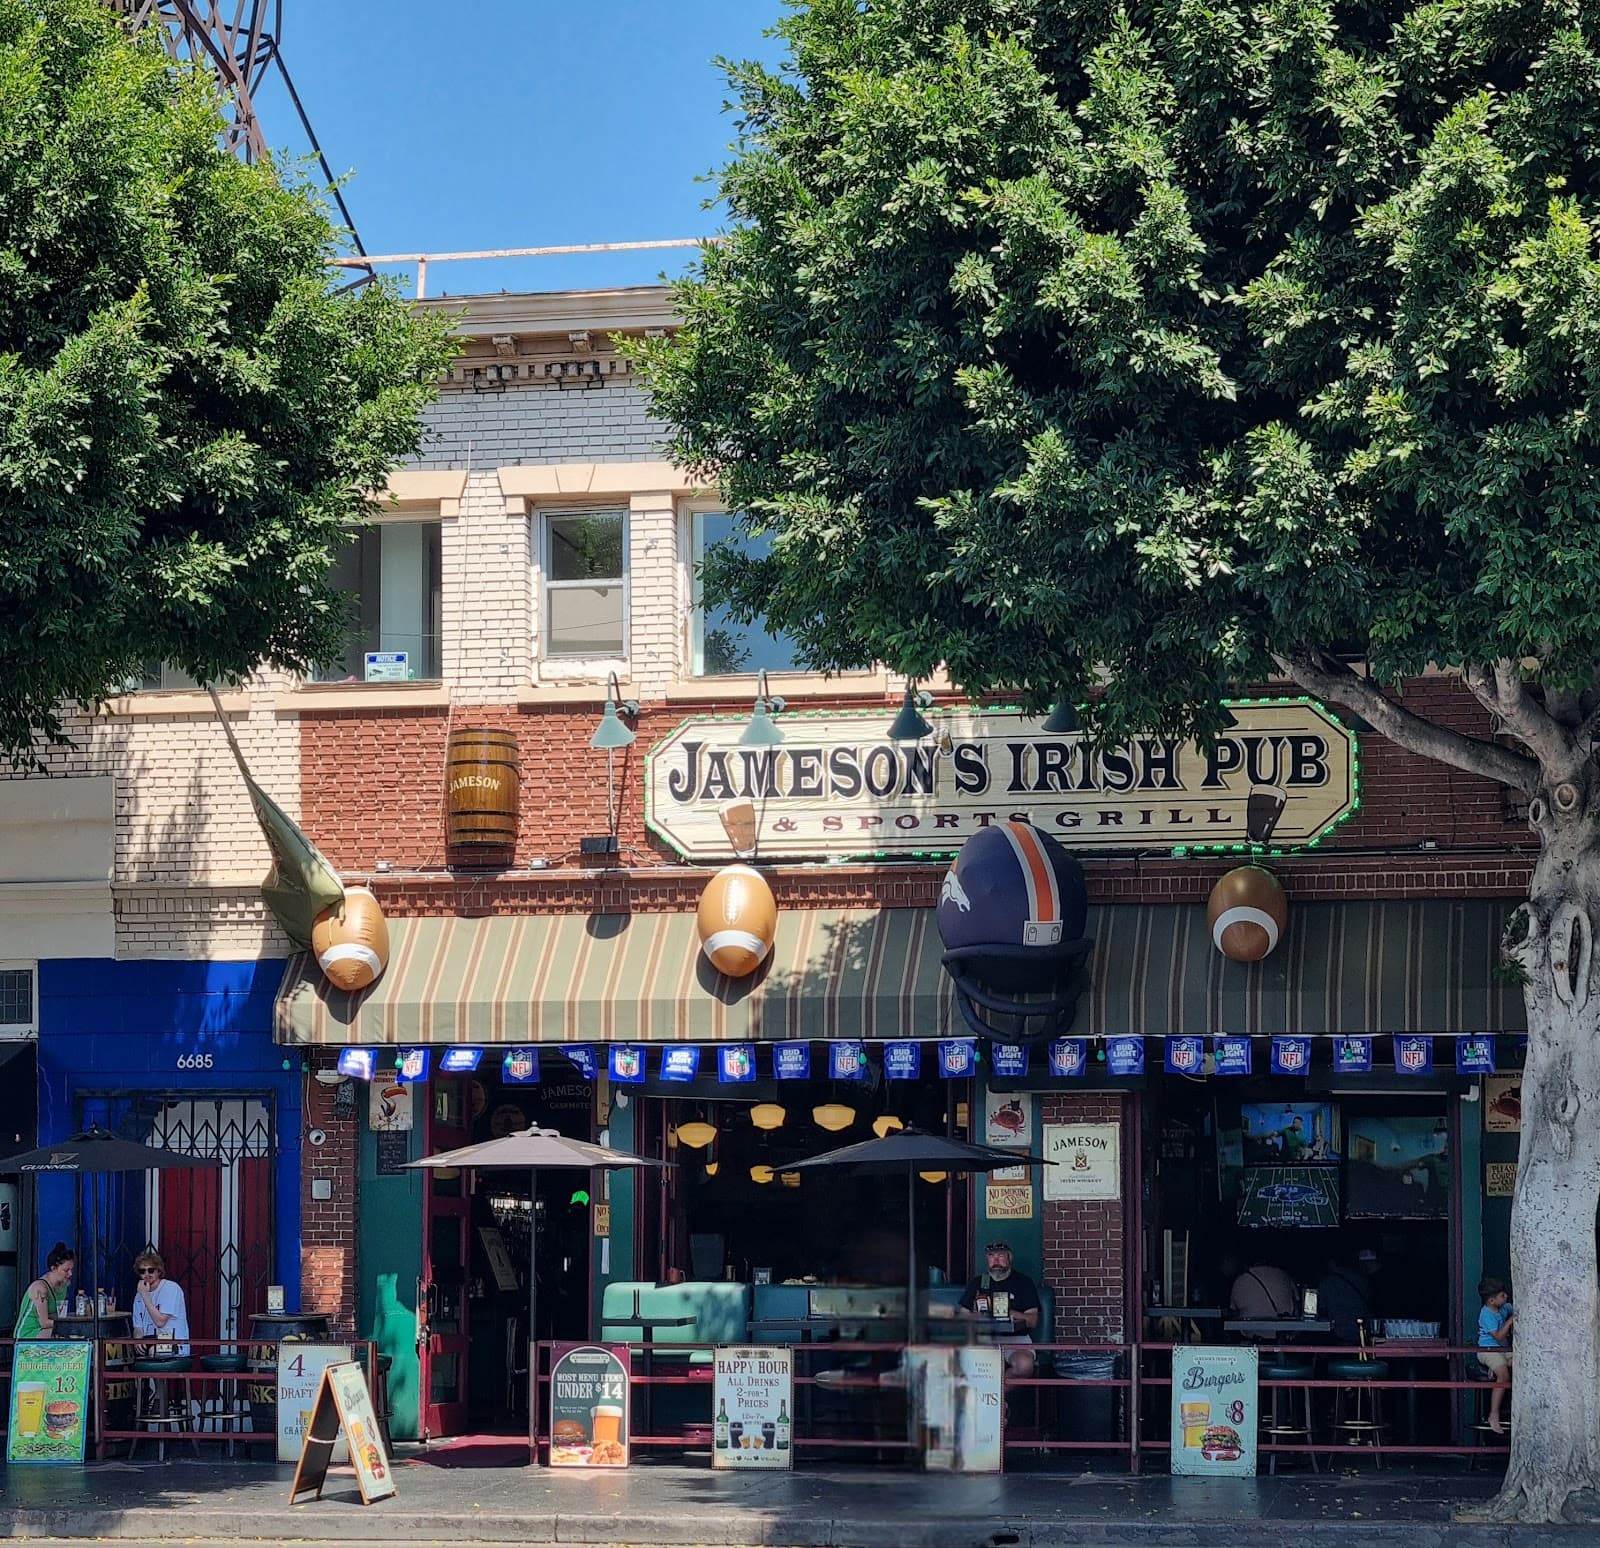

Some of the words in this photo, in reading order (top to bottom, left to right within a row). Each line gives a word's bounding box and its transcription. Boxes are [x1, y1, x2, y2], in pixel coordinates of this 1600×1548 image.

[668, 740, 988, 802] JAMESON'S
[1006, 739, 1182, 793] IRISH
[1201, 735, 1327, 788] PUB
[447, 775, 500, 794] JAMESON
[771, 816, 798, 832] &
[822, 811, 1031, 831] SPORTS
[1055, 808, 1232, 827] GRILL
[999, 1051, 1022, 1059] LIGHT
[1057, 1054, 1076, 1066] NFL
[1113, 1050, 1136, 1058] LIGHT
[1173, 1052, 1192, 1065] NFL
[1282, 1052, 1301, 1065] NFL
[1404, 1051, 1423, 1065] NFL
[176, 1053, 214, 1069] 6685
[405, 1062, 420, 1073] NFL
[838, 1058, 856, 1070] NFL
[947, 1055, 965, 1068] NFL
[511, 1062, 529, 1074] NFL
[541, 1084, 592, 1100] JAMESO
[1053, 1136, 1108, 1151] JAMESON
[20, 1163, 80, 1171] GUINNESS
[989, 1189, 999, 1200] NO
[989, 1206, 998, 1215] ON
[288, 1354, 305, 1377] 4
[718, 1361, 753, 1374] HAPPY
[758, 1361, 788, 1374] HOUR
[557, 1374, 579, 1382] MOST
[579, 1374, 598, 1382] MENU
[600, 1374, 624, 1382] ITEMS
[1181, 1366, 1247, 1394] Burgers
[281, 1388, 313, 1399] DRAFT
[557, 1383, 593, 1398] UNDER
[594, 1382, 624, 1399] $14
